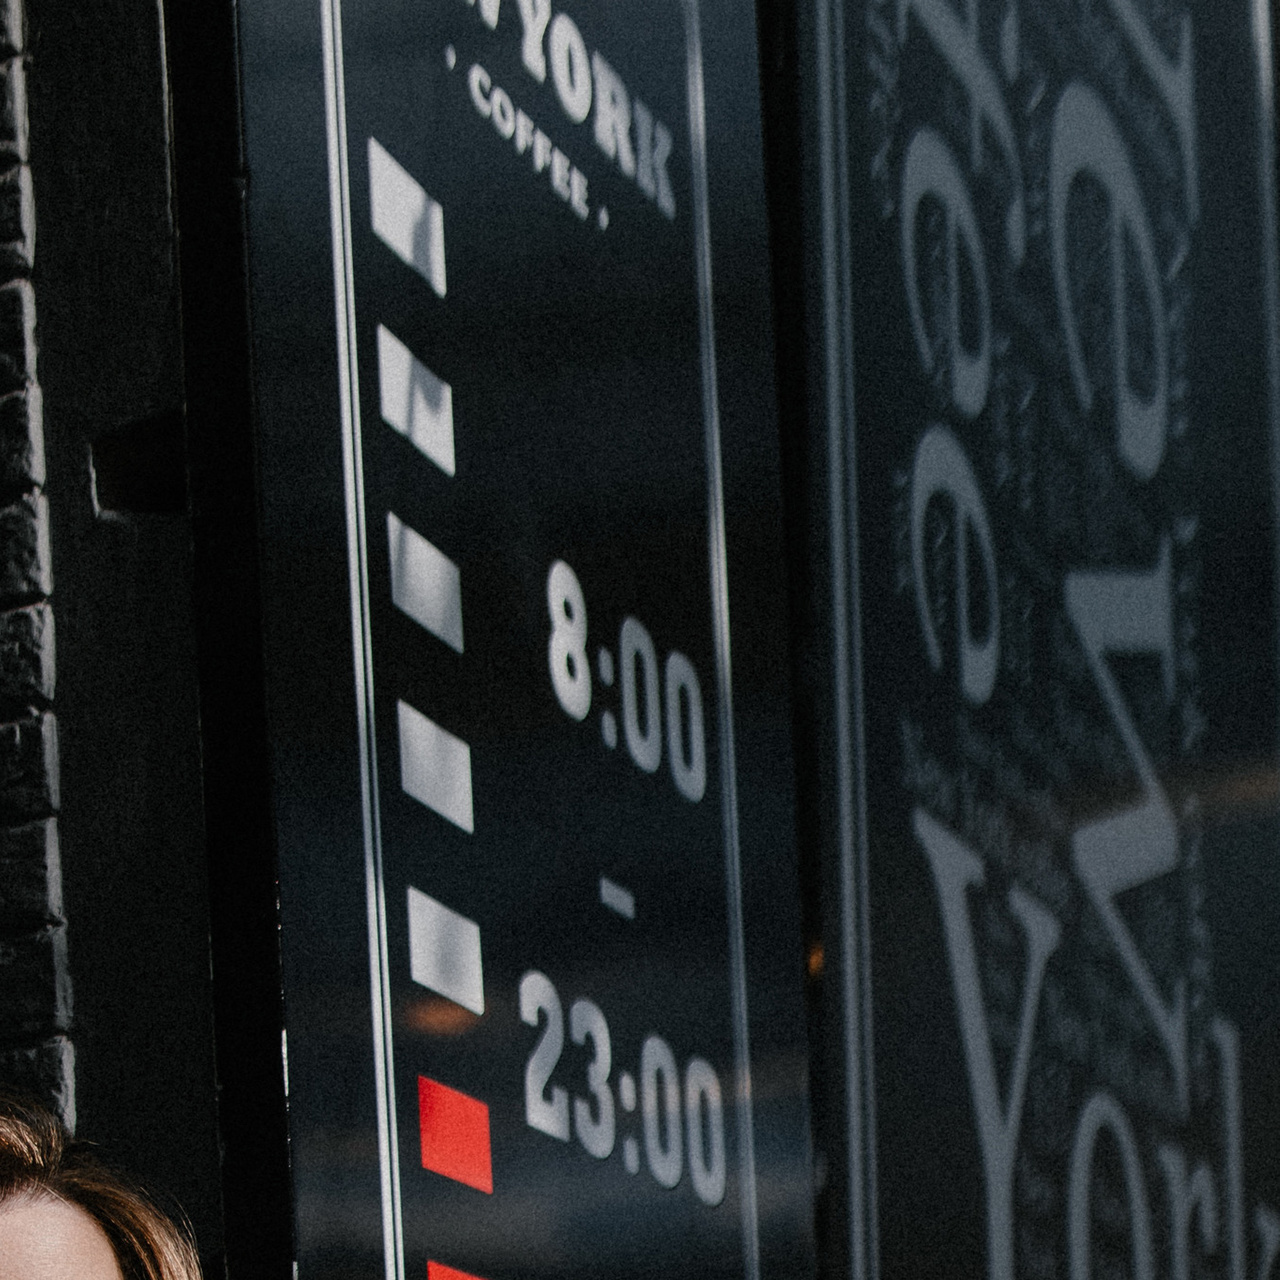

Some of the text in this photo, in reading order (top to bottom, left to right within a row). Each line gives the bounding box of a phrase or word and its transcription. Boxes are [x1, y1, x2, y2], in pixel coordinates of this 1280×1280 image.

[468, 62, 590, 222] COFFEE
[518, 0, 677, 222] YORK
[547, 557, 707, 803] 8:00
[519, 969, 726, 1207] 23:00
